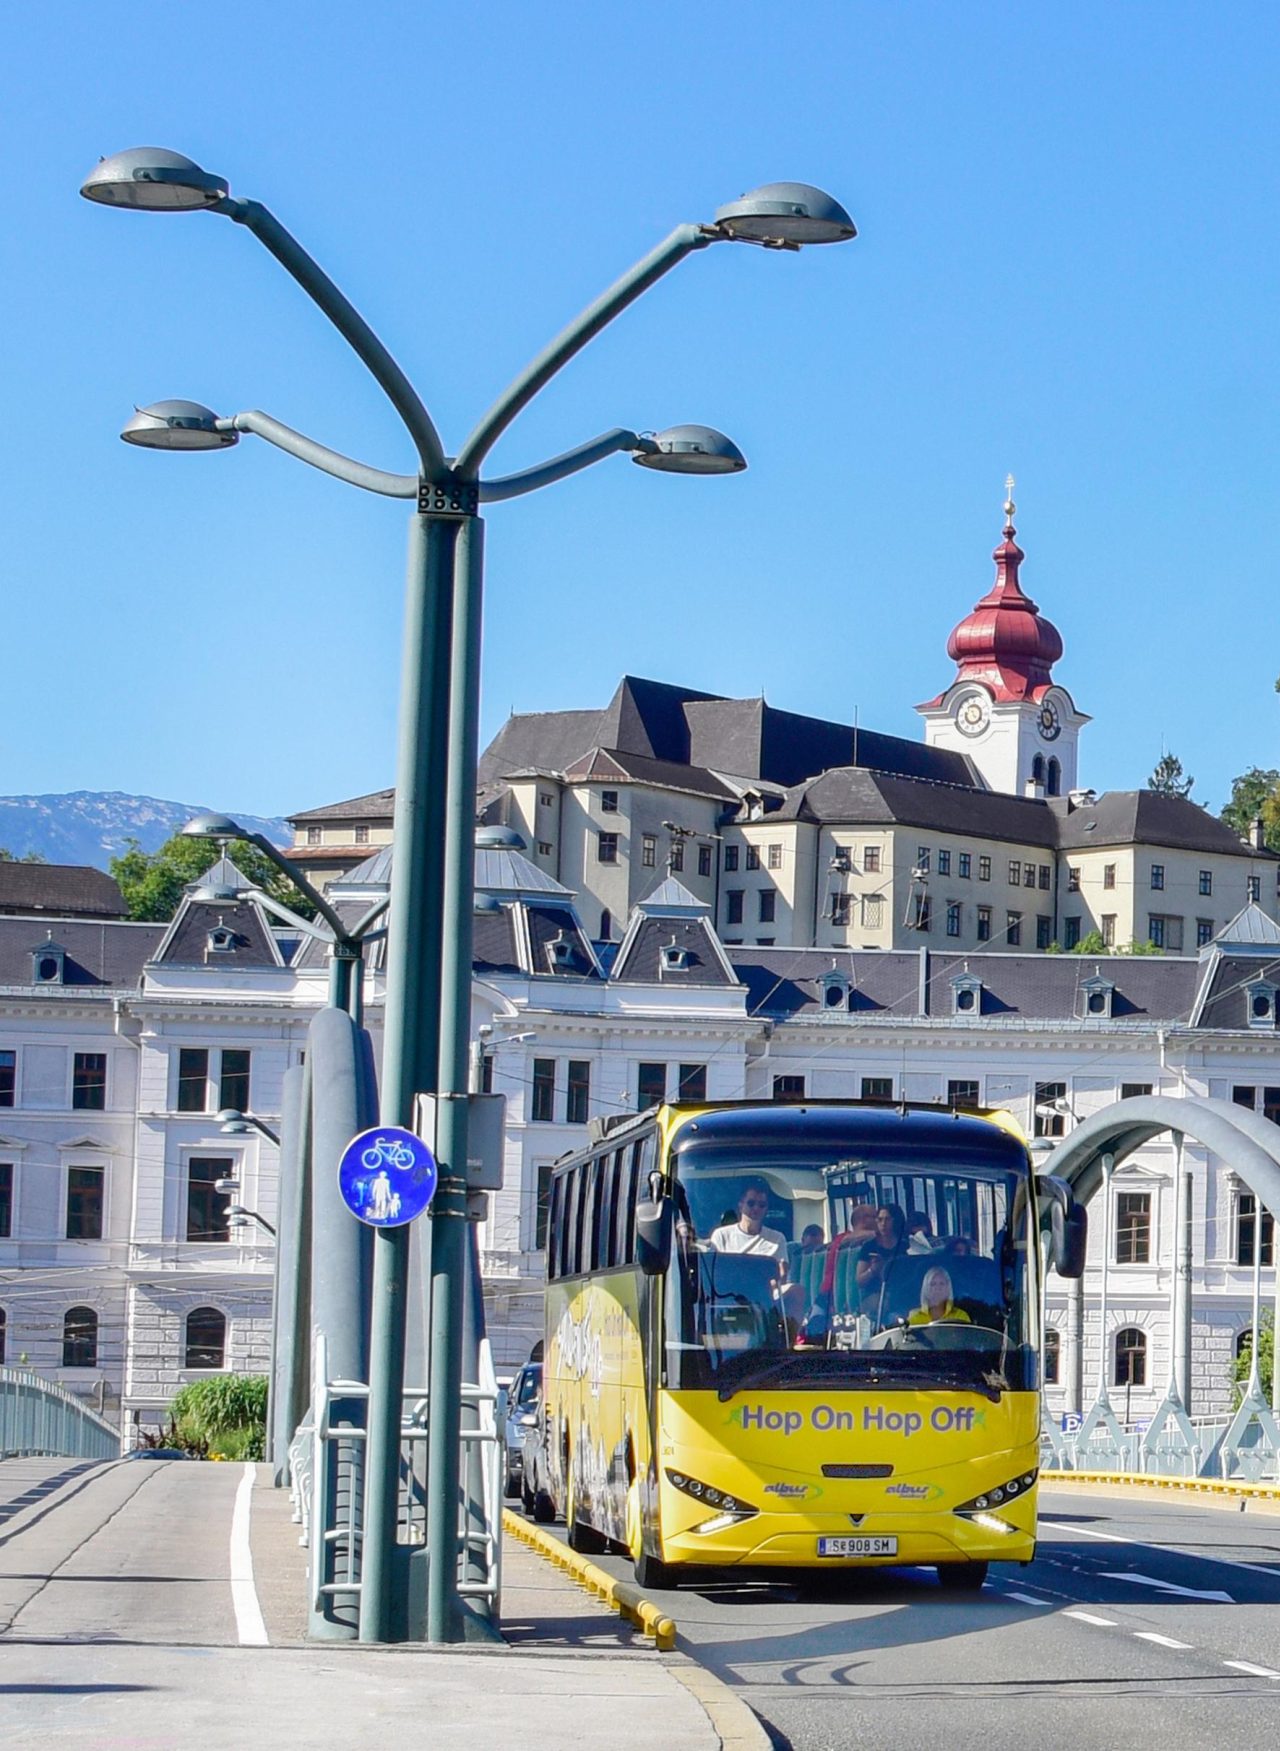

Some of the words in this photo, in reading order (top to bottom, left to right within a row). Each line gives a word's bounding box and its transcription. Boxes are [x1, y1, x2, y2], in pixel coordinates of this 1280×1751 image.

[742, 1405, 802, 1436] Hop
[811, 1405, 853, 1430] On
[863, 1406, 922, 1437] Hop
[931, 1406, 975, 1432] Off
